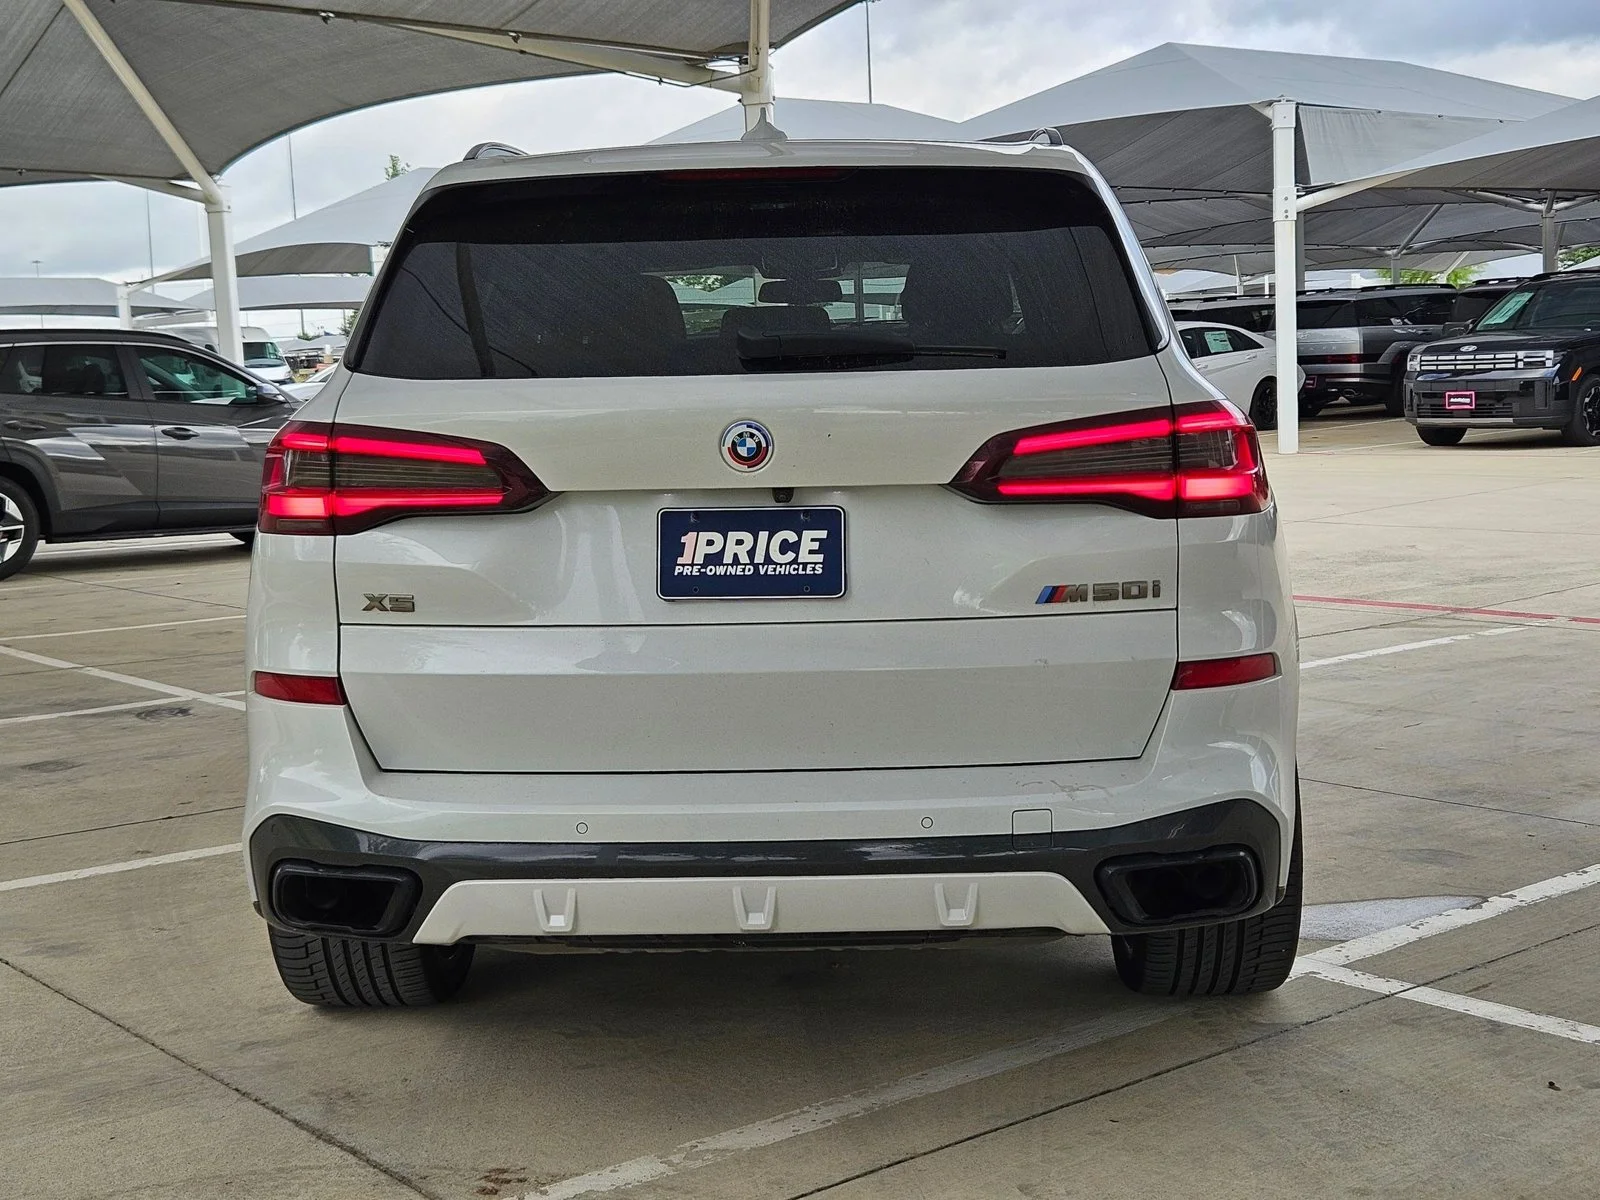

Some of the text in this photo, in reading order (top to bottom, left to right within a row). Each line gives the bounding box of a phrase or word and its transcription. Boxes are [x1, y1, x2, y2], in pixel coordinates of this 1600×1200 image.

[733, 431, 760, 443] BMW
[674, 564, 823, 576] PRE-OWNED VEHICLES
[362, 594, 415, 612] X5
